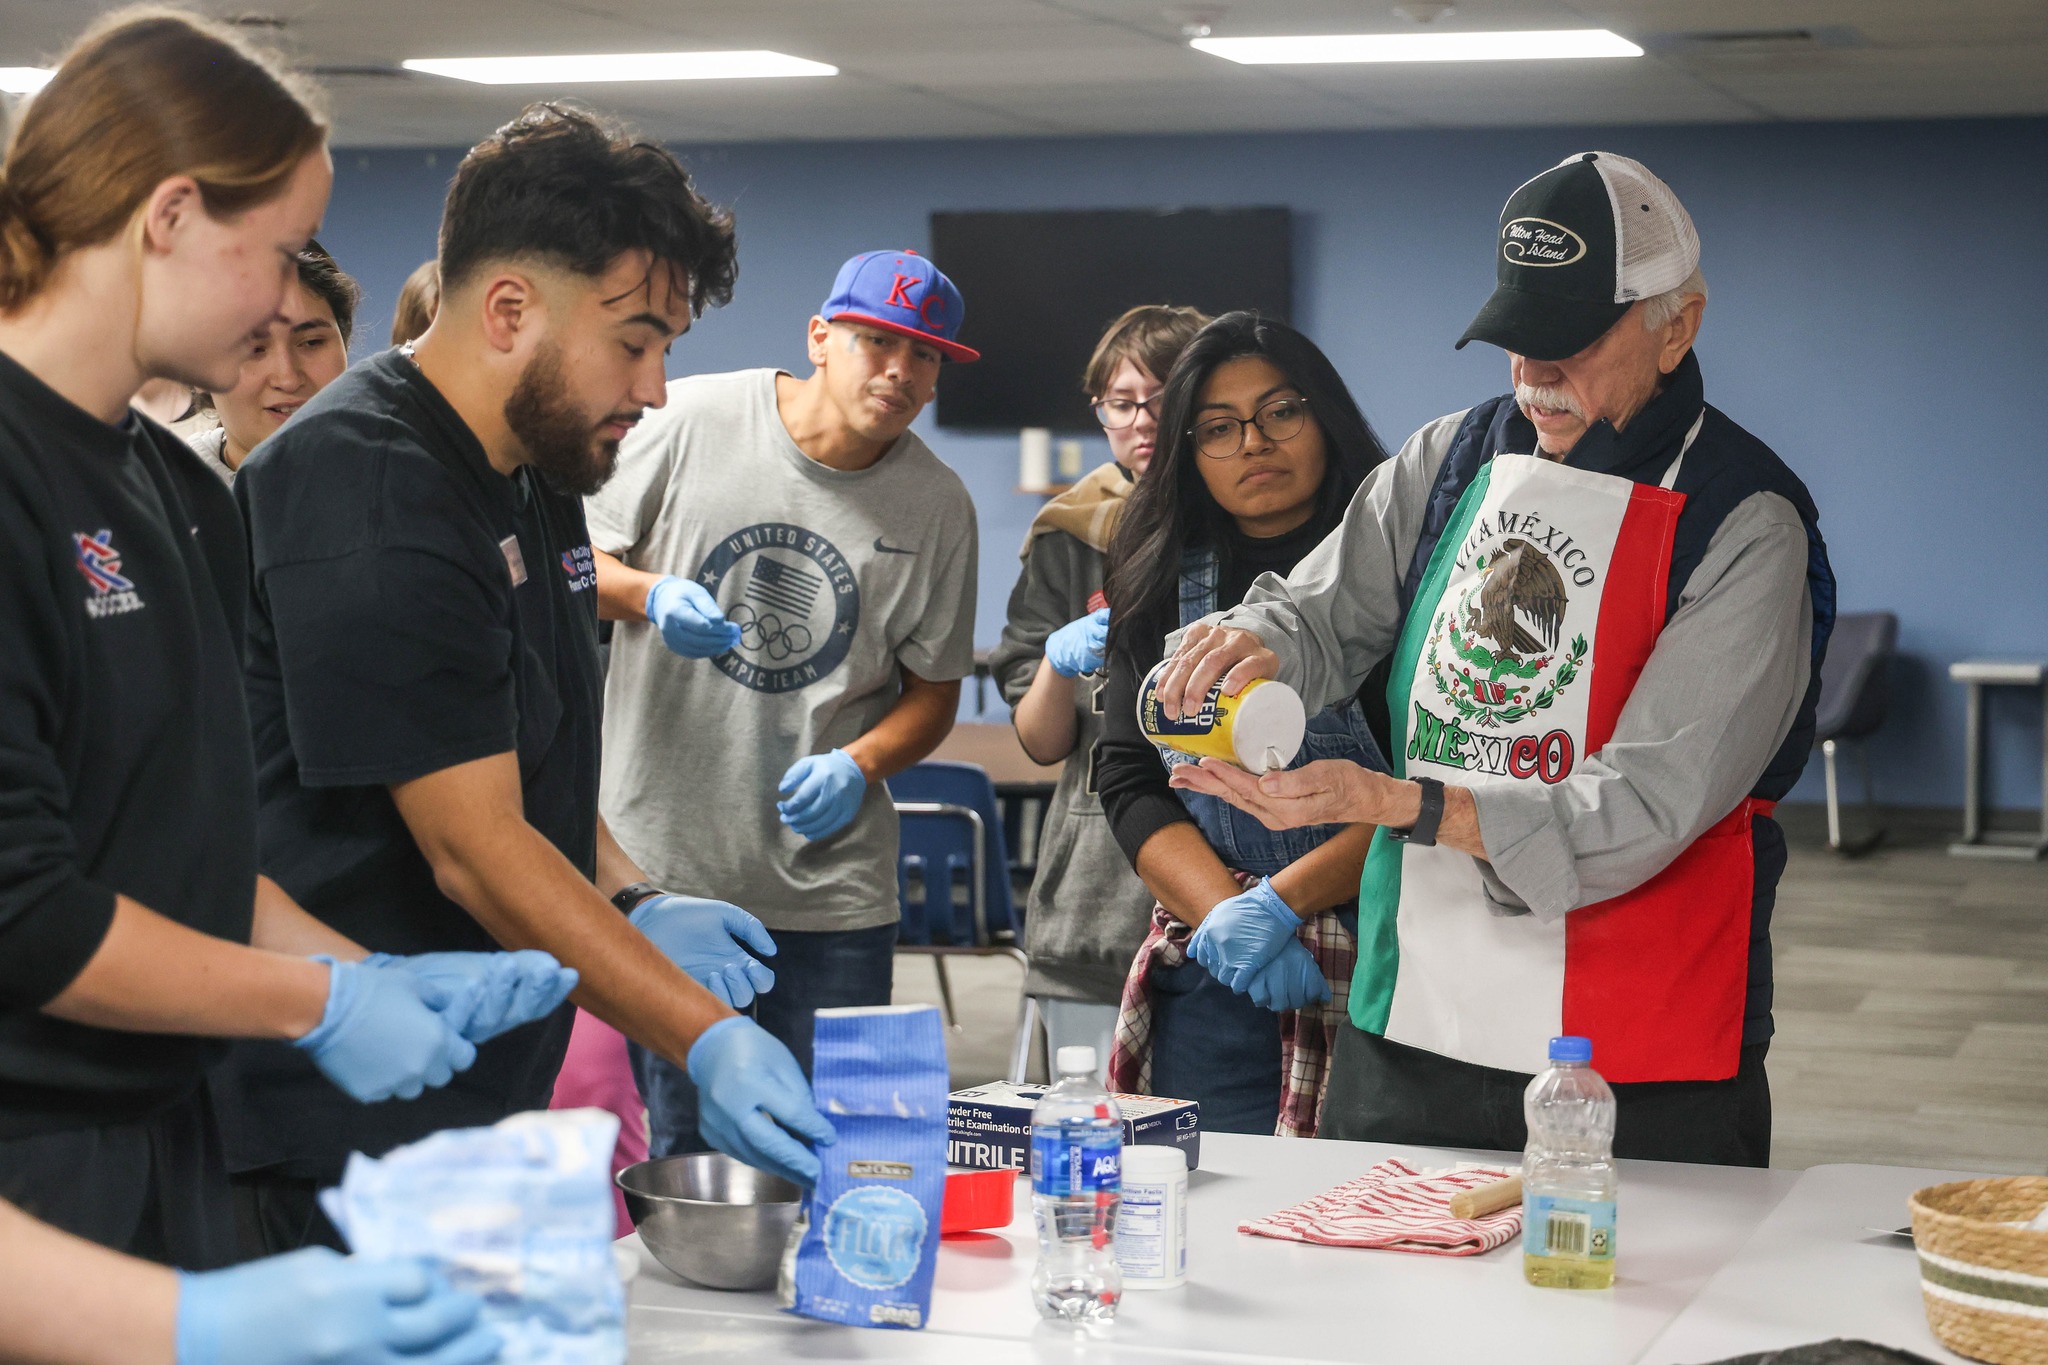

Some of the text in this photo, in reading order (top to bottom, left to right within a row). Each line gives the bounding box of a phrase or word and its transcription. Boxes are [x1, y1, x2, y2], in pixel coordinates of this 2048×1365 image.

[1526, 243, 1569, 261] Island
[1535, 229, 1567, 245] Head
[884, 272, 945, 330] KC
[729, 527, 853, 595] UNITED STATES
[1497, 510, 1596, 588] MÉXICO
[719, 654, 818, 689] MPIC TEAM
[1407, 700, 1575, 785] MÉXICO
[947, 1106, 993, 1120] wder Free
[947, 1117, 965, 1128] trile
[966, 1119, 1021, 1135] Examination
[946, 1139, 1025, 1171] NITRILE
